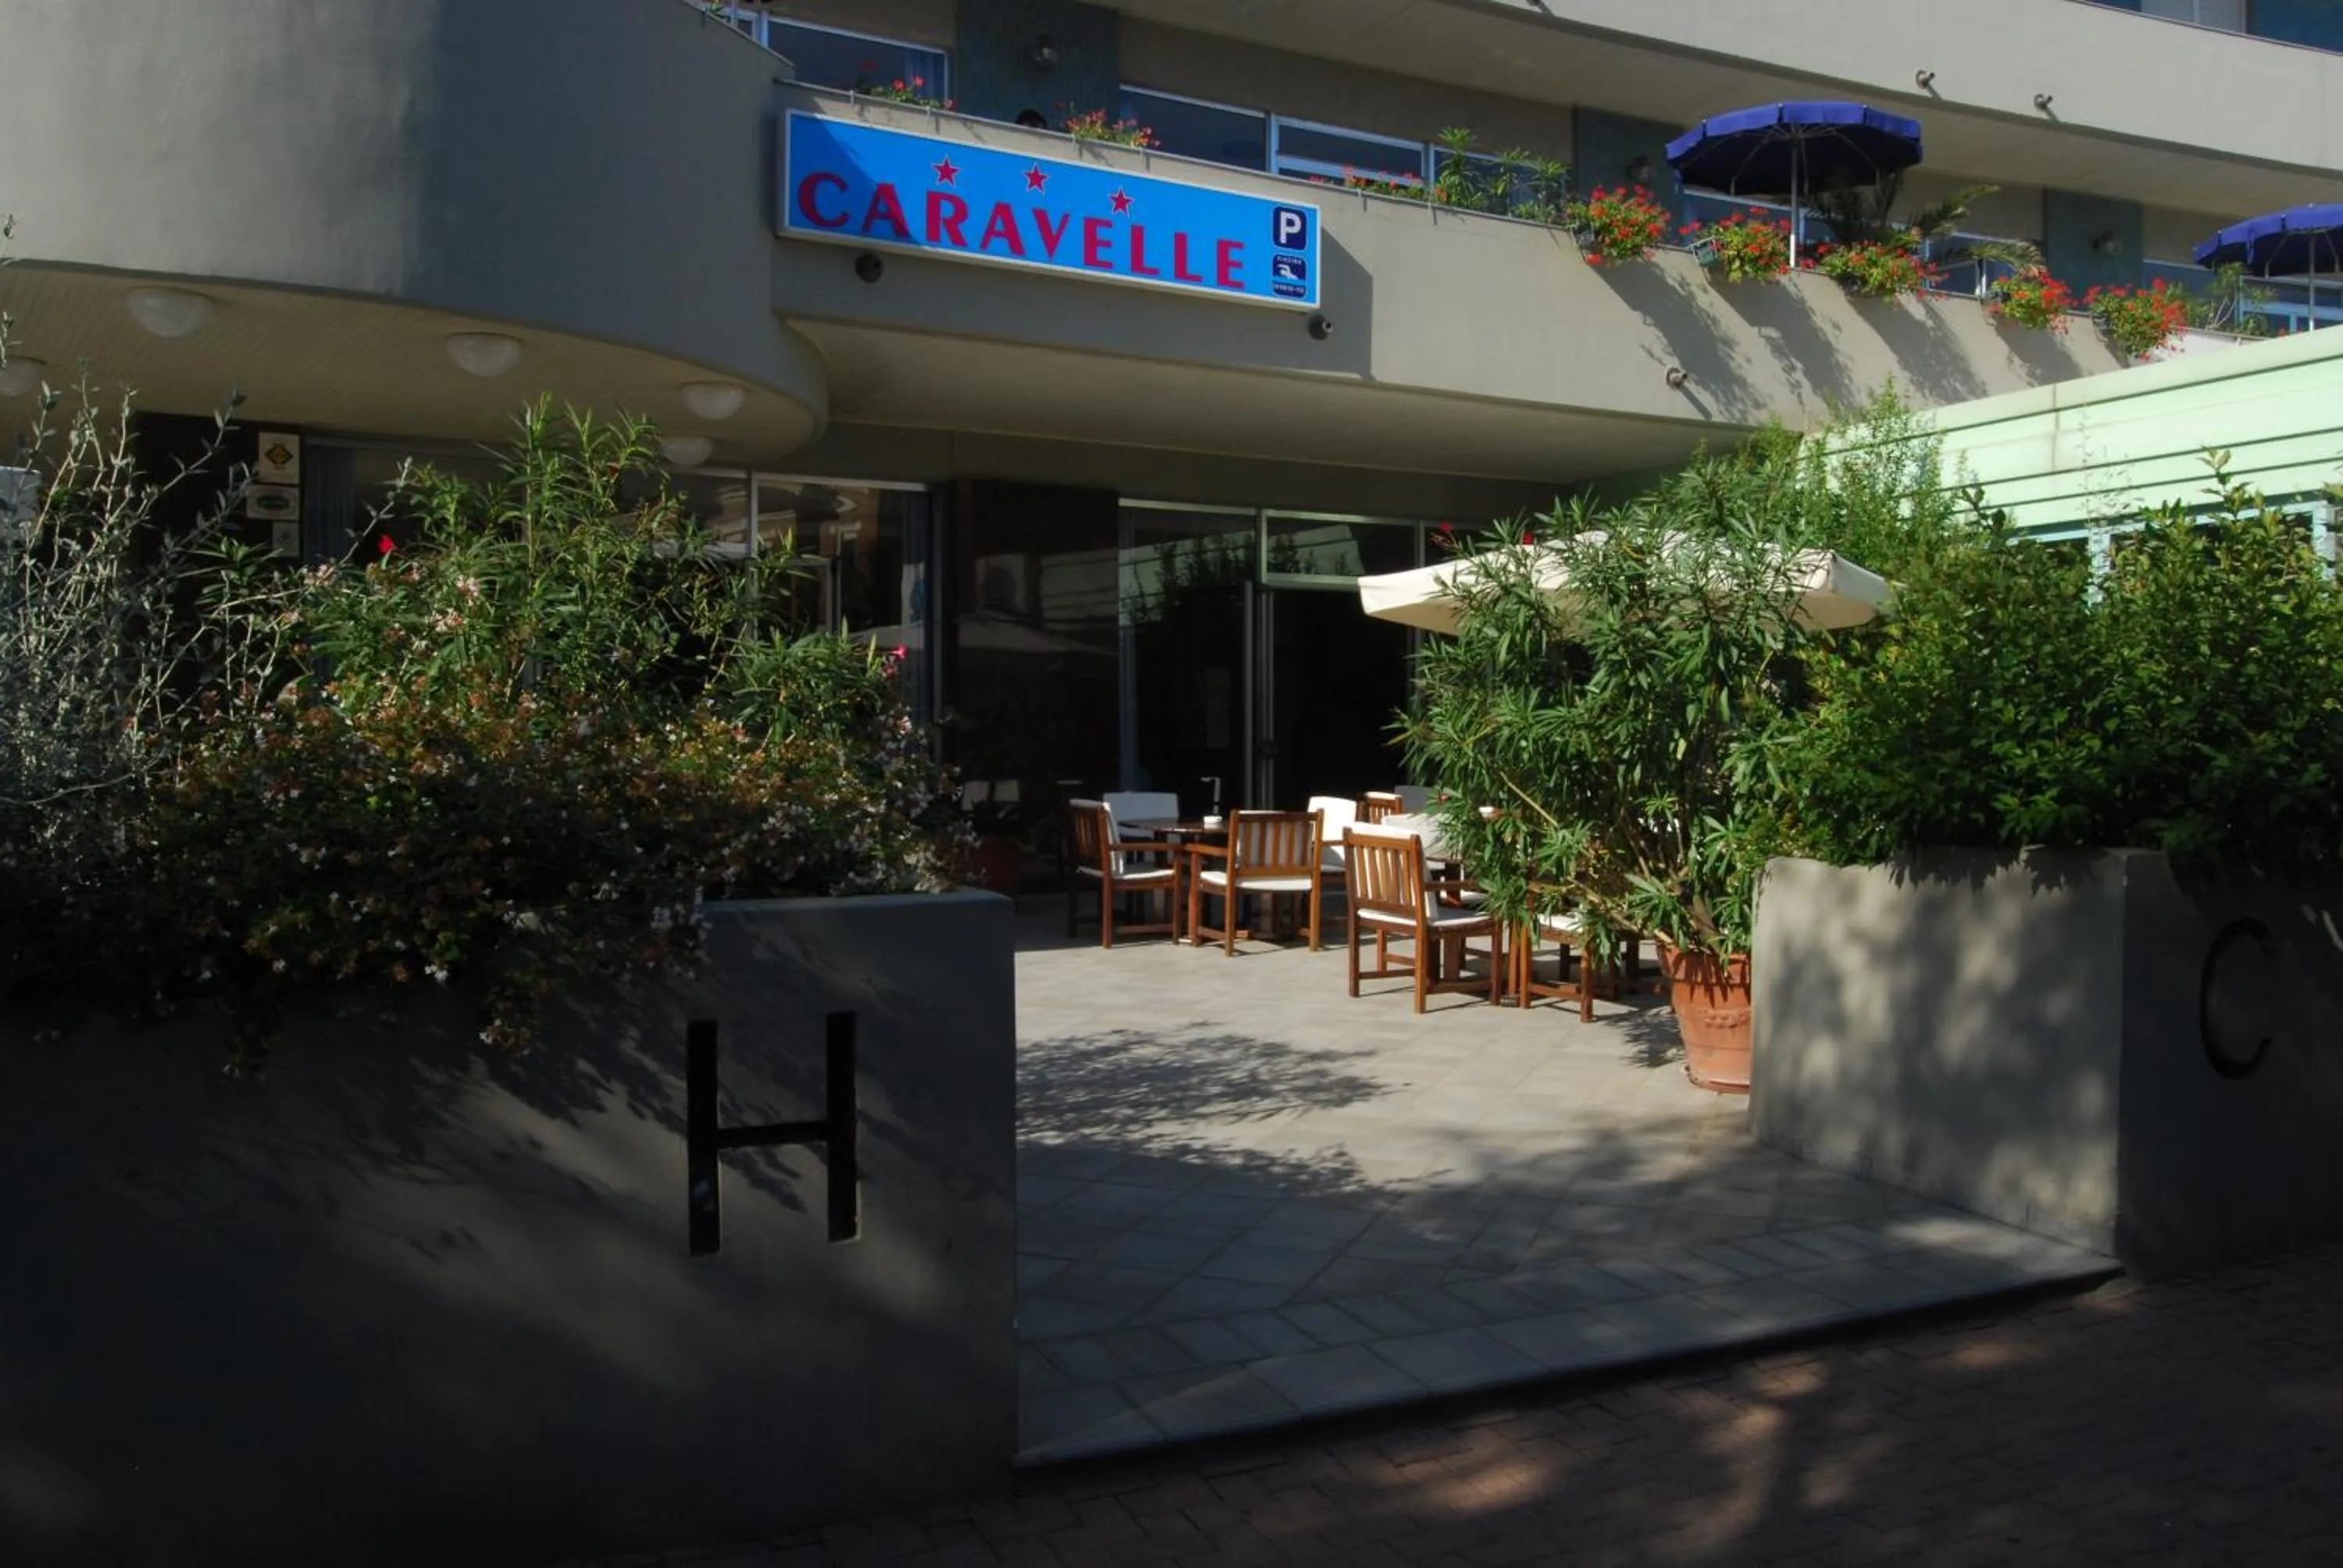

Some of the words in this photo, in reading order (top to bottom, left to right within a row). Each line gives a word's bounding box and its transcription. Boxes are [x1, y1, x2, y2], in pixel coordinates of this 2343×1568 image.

[797, 171, 1245, 290] CARAVELLE
[1279, 210, 1302, 244] P
[2199, 916, 2274, 1080] C
[687, 1010, 857, 1256] H
